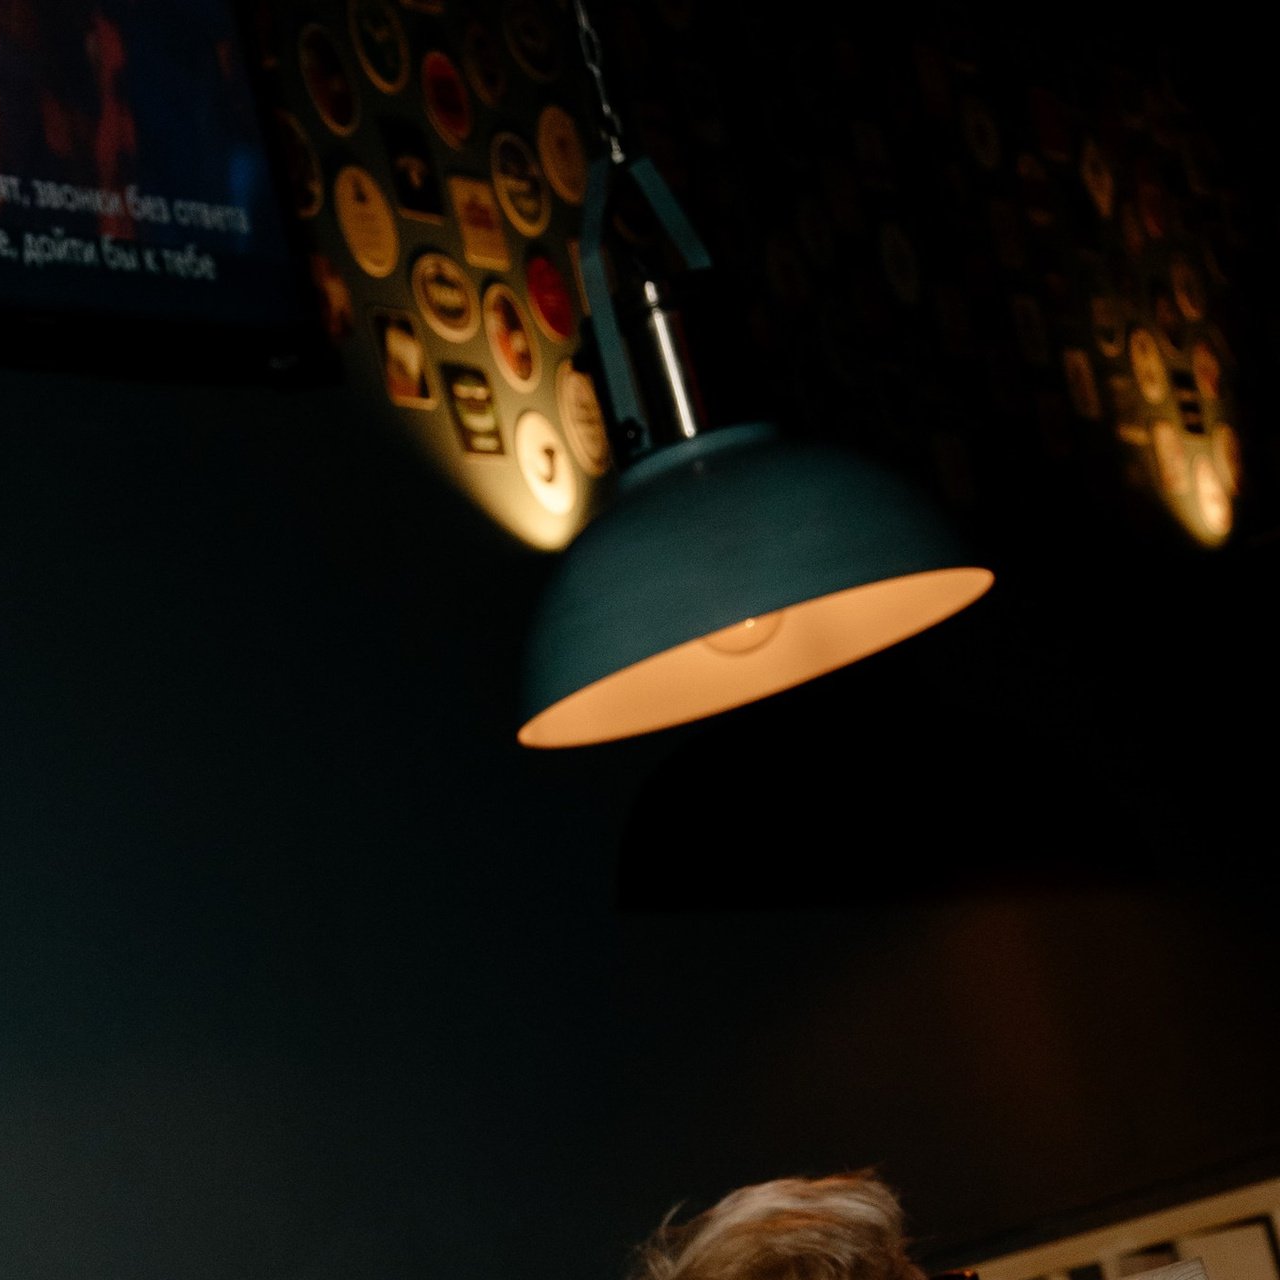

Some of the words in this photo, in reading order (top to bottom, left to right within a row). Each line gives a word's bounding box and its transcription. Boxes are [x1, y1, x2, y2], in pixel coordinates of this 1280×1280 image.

[125, 184, 172, 225] без
[22, 226, 100, 269] дойти
[101, 234, 141, 272] бы
[143, 247, 161, 274] к
[161, 243, 217, 281] тебе
